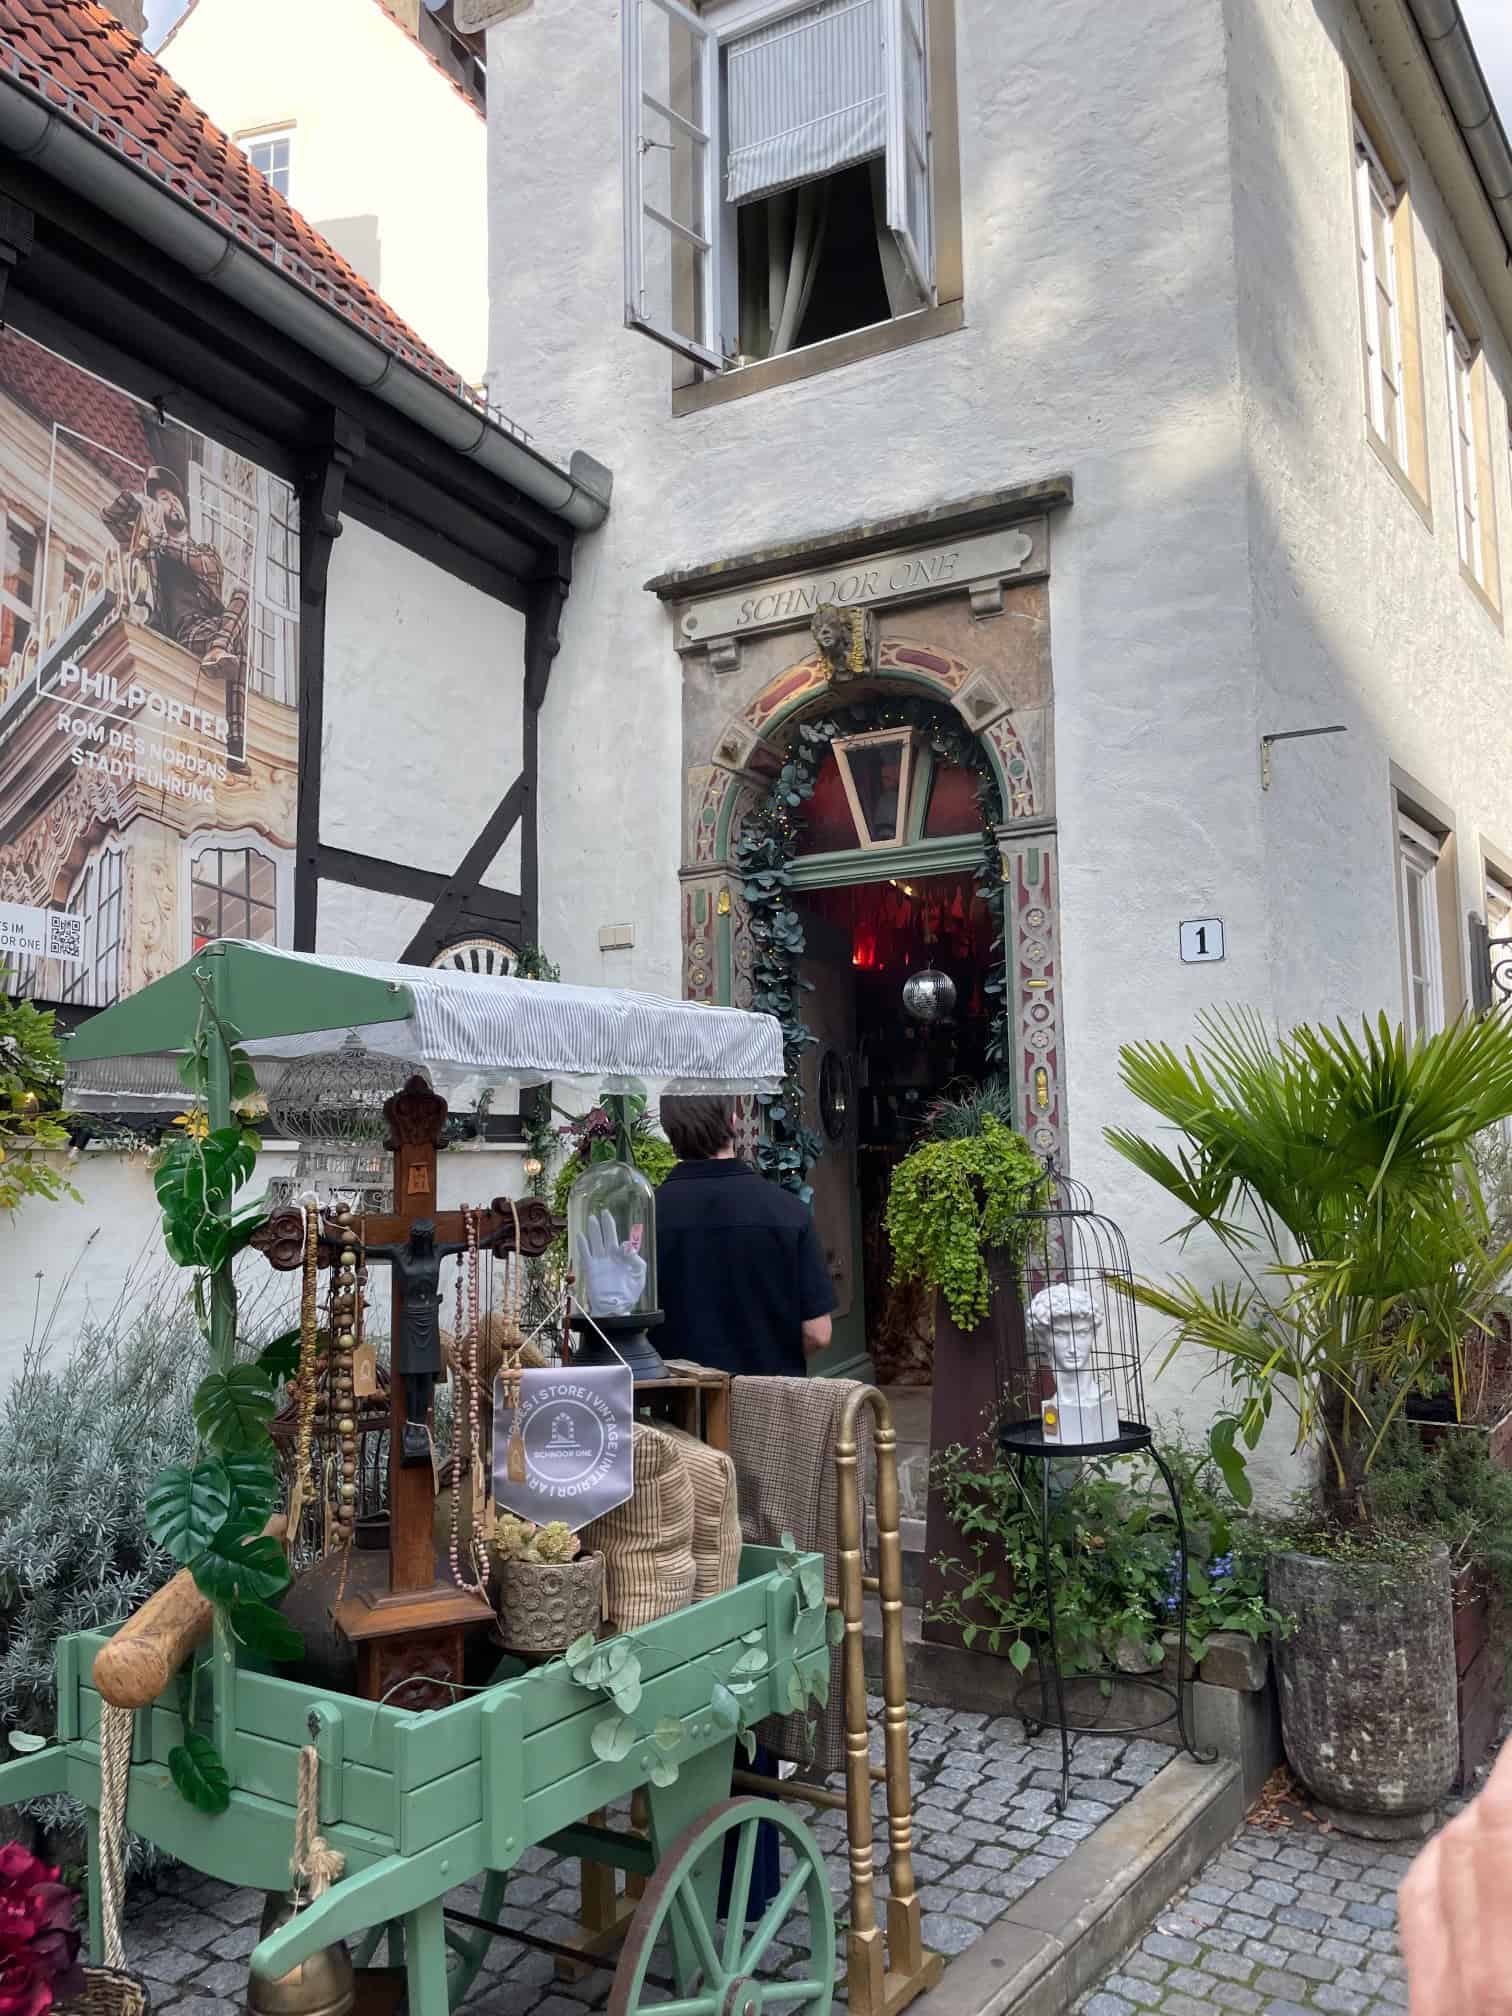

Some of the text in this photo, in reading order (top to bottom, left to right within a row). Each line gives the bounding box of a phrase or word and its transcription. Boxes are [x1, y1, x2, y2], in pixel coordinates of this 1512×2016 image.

[737, 553, 960, 624] SCHNOOR ONE
[60, 663, 230, 743] PHILPORTER
[57, 713, 226, 782] ROM DES NORDENS
[11, 922, 23, 934] IM
[19, 938, 41, 950] ONE
[1195, 927, 1209, 954] 1
[541, 1385, 587, 1400] STORE
[593, 1396, 618, 1450] VINTAGE
[558, 1459, 615, 1497] INTERIOR
